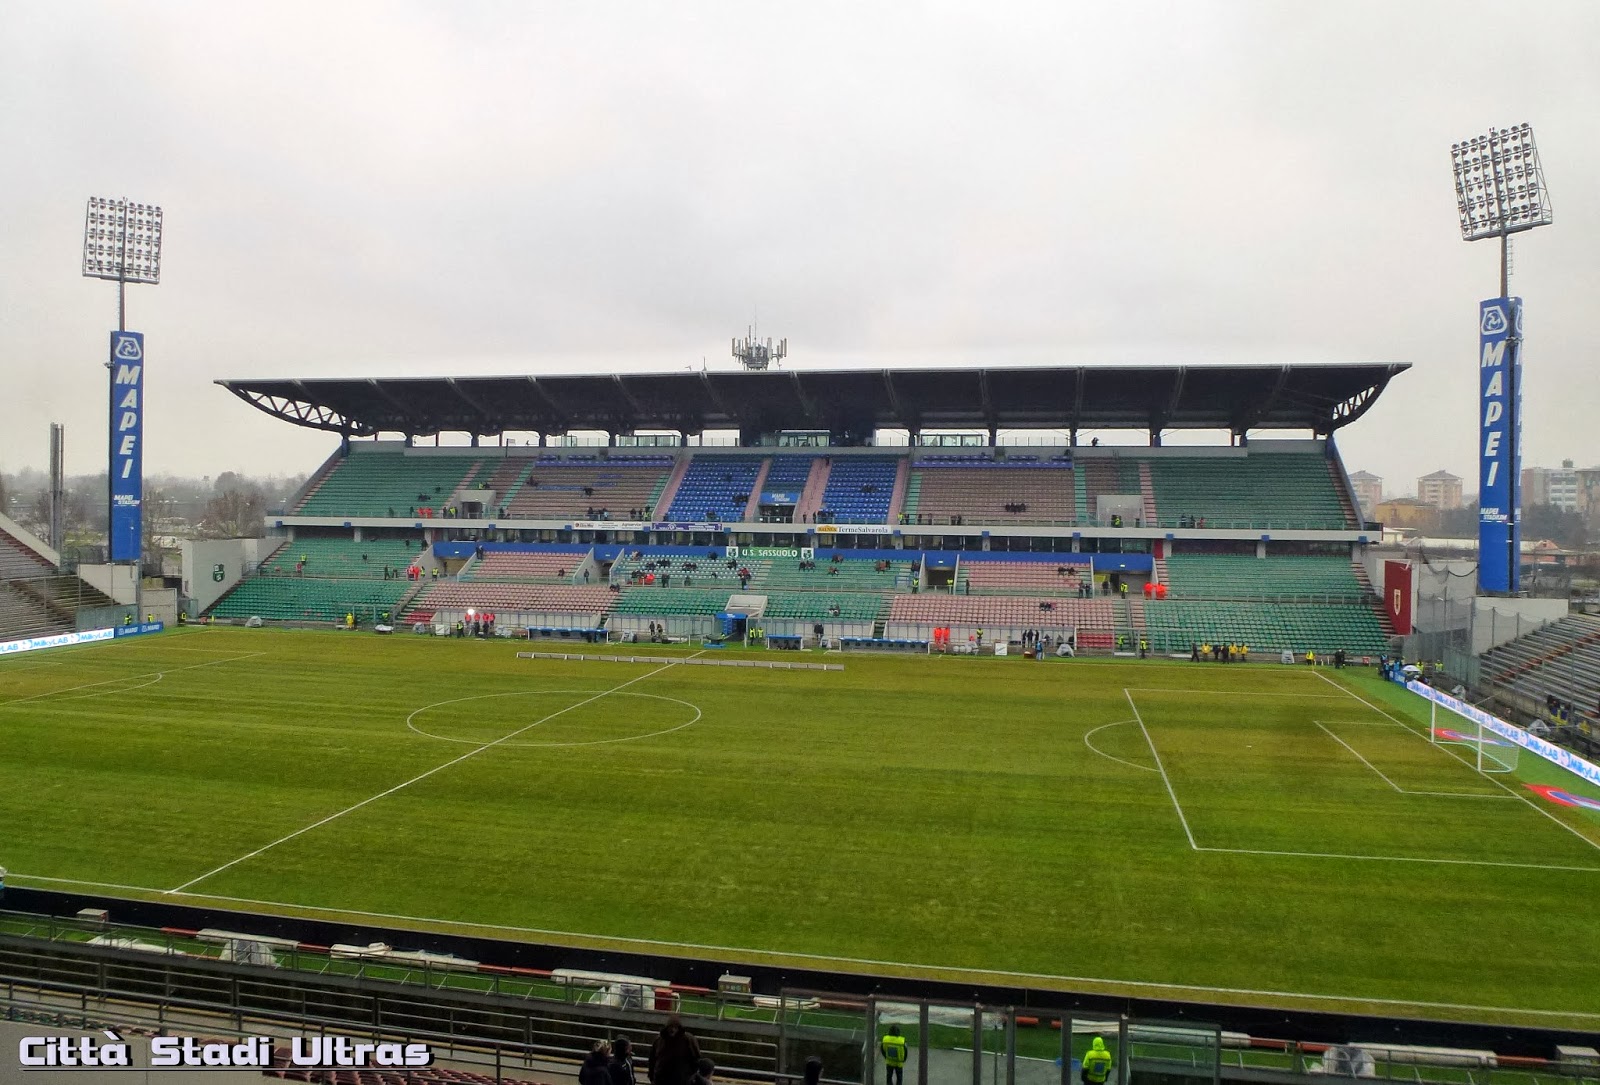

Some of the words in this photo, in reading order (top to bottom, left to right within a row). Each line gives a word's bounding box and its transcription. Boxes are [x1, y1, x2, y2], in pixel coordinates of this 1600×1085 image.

[115, 365, 142, 479] MAPEI
[1481, 341, 1506, 487] MAPEI
[758, 549, 798, 557] SASSUOLO
[33, 636, 69, 647] MilkyLAB
[81, 630, 113, 641] MilkyLAB
[1528, 738, 1559, 761] MilkyLAB
